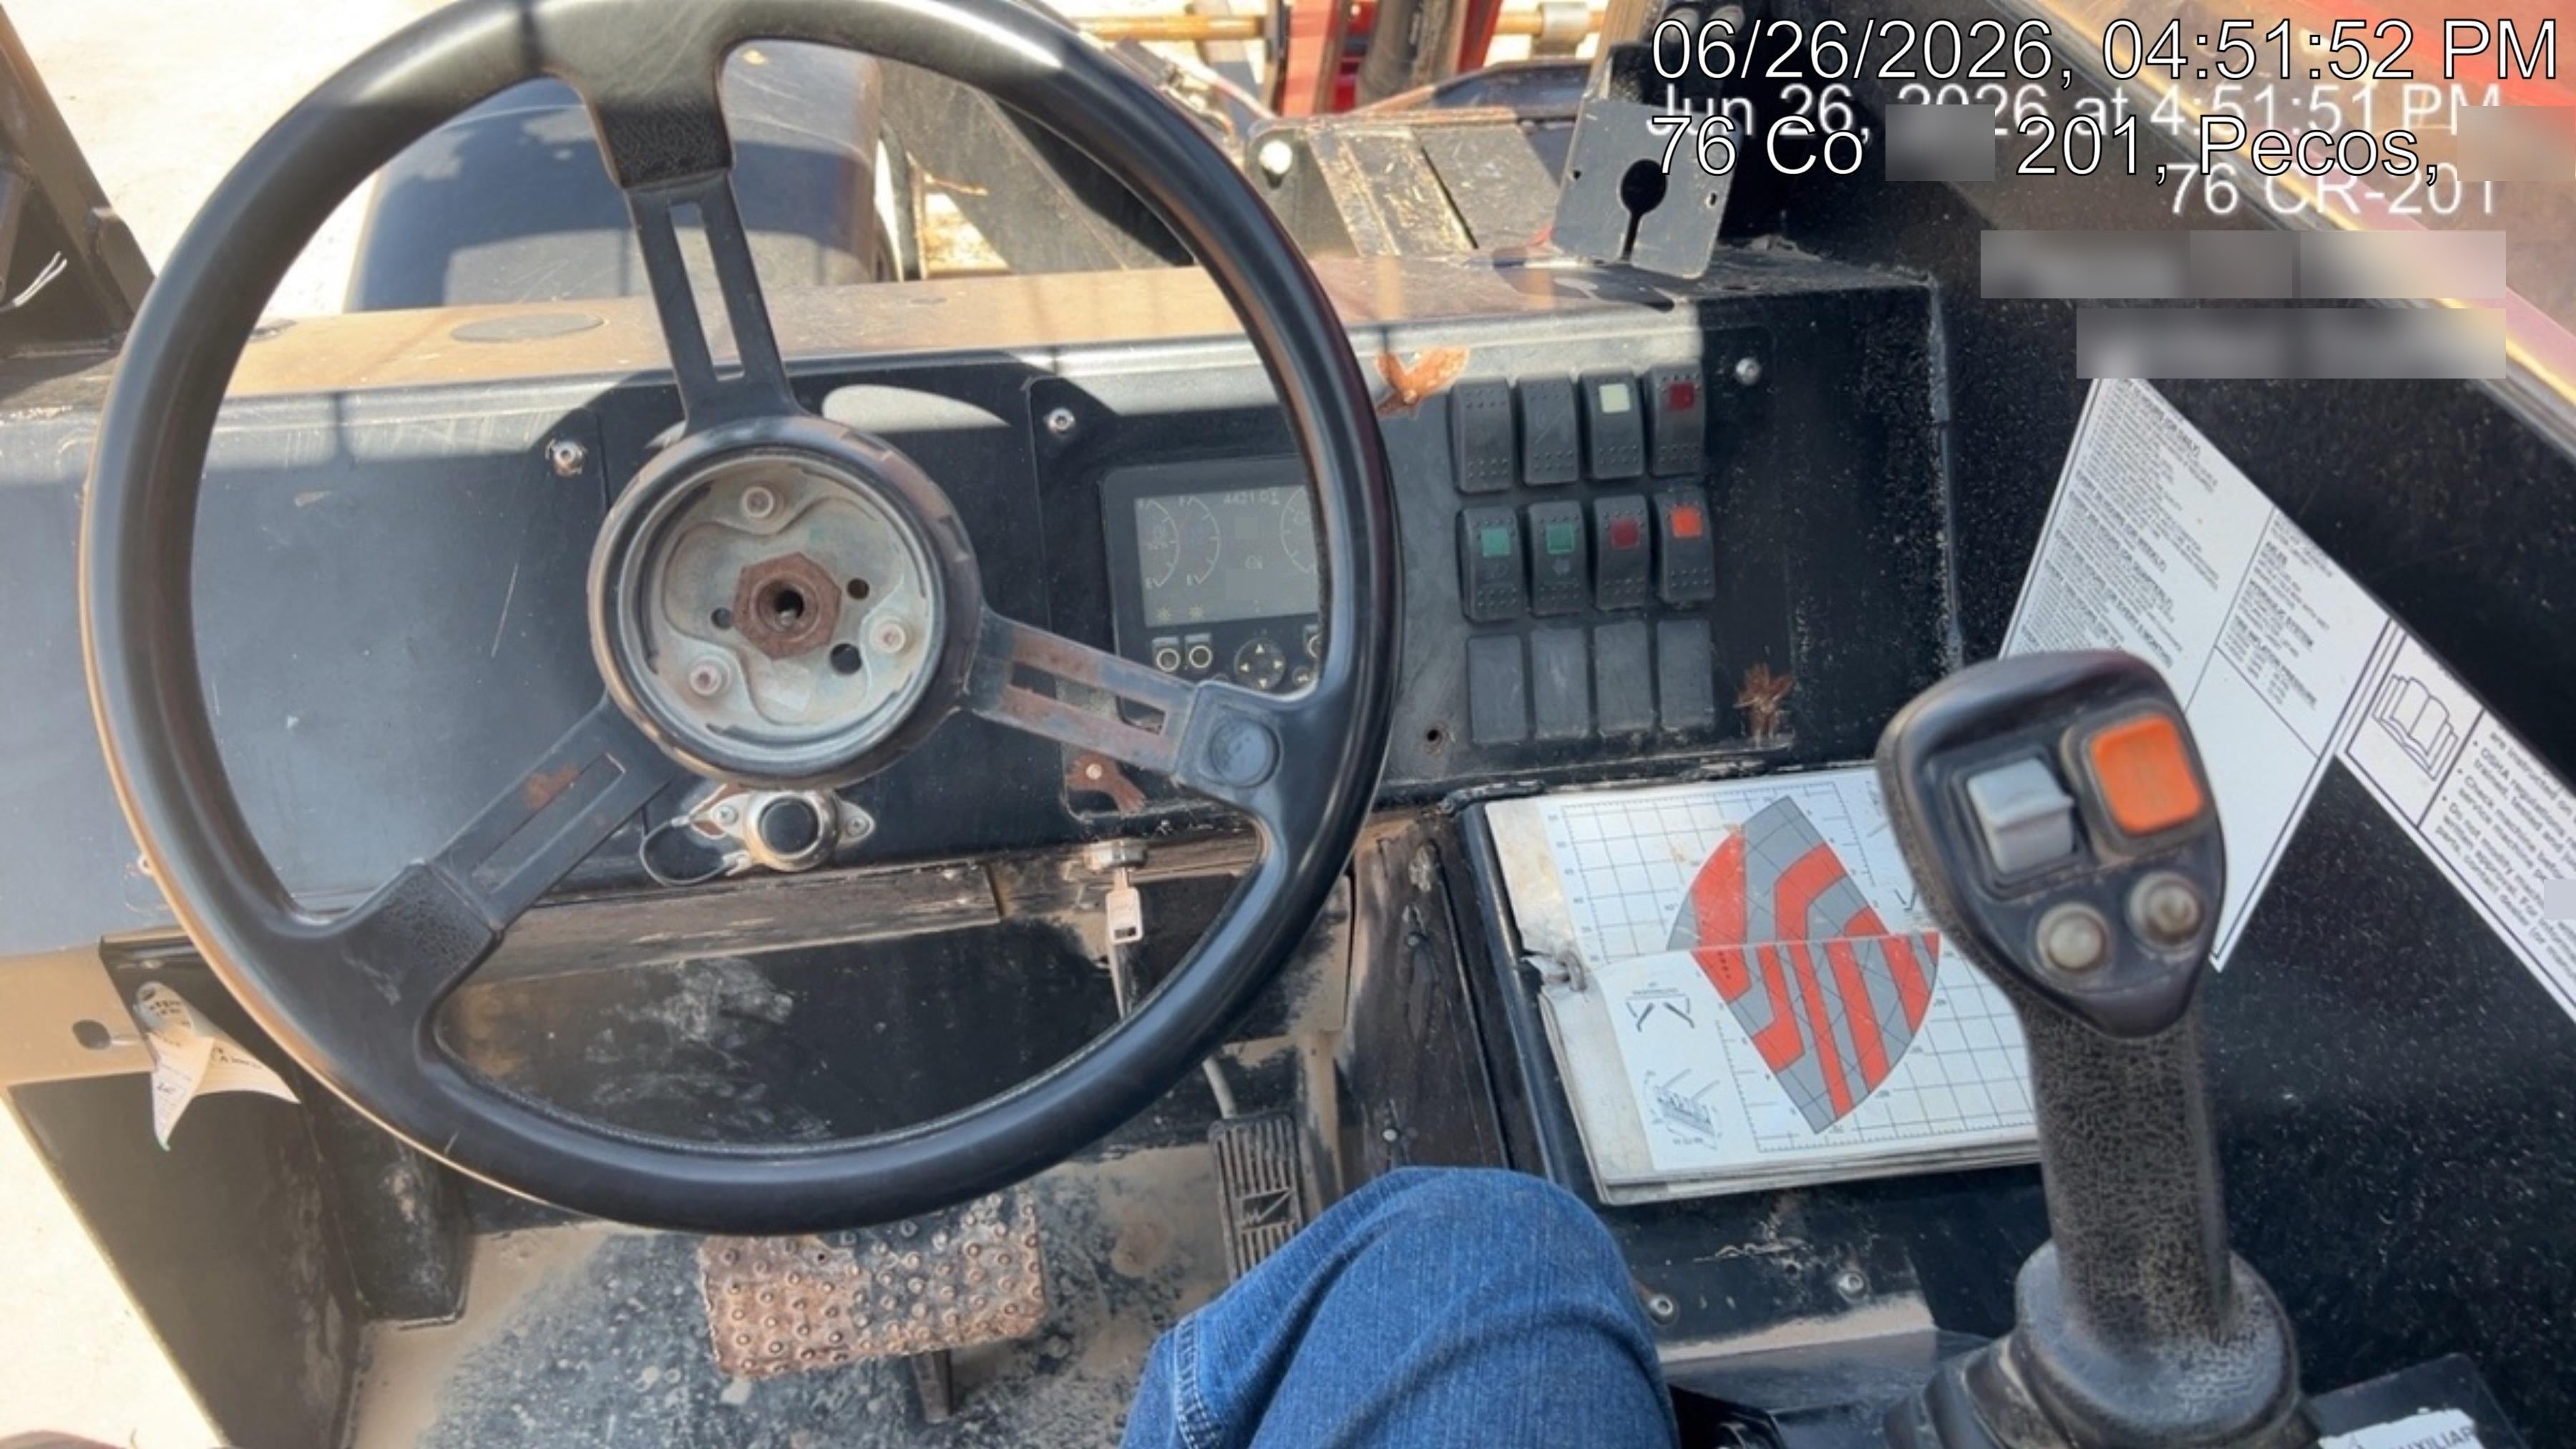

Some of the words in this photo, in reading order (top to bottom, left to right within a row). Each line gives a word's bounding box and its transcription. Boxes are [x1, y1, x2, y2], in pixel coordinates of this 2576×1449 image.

[2463, 773, 2496, 812] Check
[2494, 806, 2537, 857] machine
[2472, 757, 2510, 801] trained,
[2510, 796, 2543, 836] tested
[2542, 829, 2565, 857] and
[2479, 744, 2511, 782] OSHA
[2508, 776, 2566, 843] regulations
[2506, 744, 2558, 805] instructed
[2557, 797, 2574, 819] on
[2442, 814, 2475, 852] written
[2447, 801, 2464, 824] Do
[2462, 817, 2482, 842] not
[2477, 836, 2515, 881] modify
[2457, 786, 2492, 829] service
[2491, 822, 2535, 873] machine
[2434, 824, 2464, 860] parts,
[2462, 854, 2499, 898] contact
[2498, 893, 2530, 932] dealer
